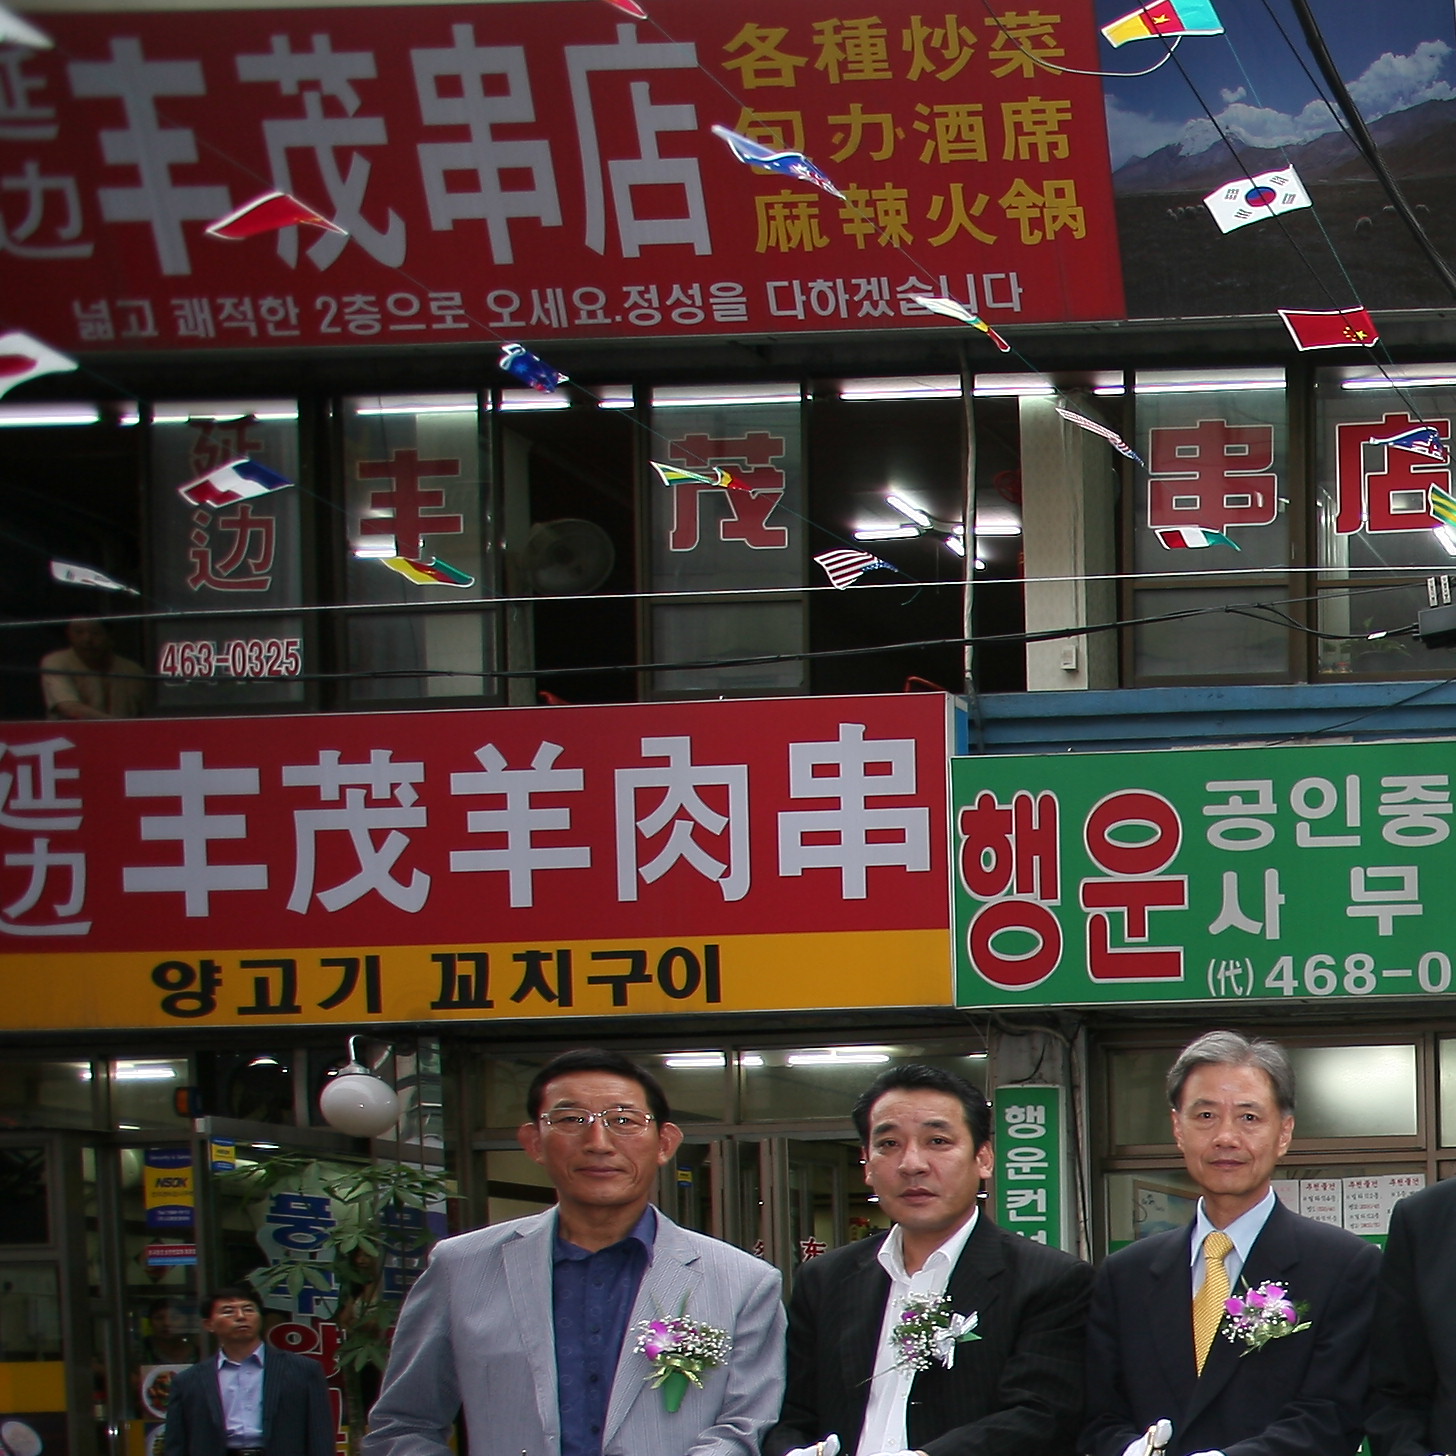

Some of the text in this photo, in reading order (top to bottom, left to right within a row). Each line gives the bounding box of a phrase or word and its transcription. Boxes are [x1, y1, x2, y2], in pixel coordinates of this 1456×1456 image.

[722, 10, 1066, 89] 各種炒菜
[67, 23, 713, 275] 丰茂串店
[754, 178, 1087, 253] 麻辣火锅
[170, 296, 301, 338] 쾌적한
[315, 291, 467, 335] 2층으로
[767, 271, 1023, 318] 다하겠습니다
[161, 638, 302, 680] 463-0325
[123, 723, 932, 918] 丰茂羊肉串
[958, 788, 1190, 992] 행운
[151, 944, 722, 1018] 양고기 꼬치구이
